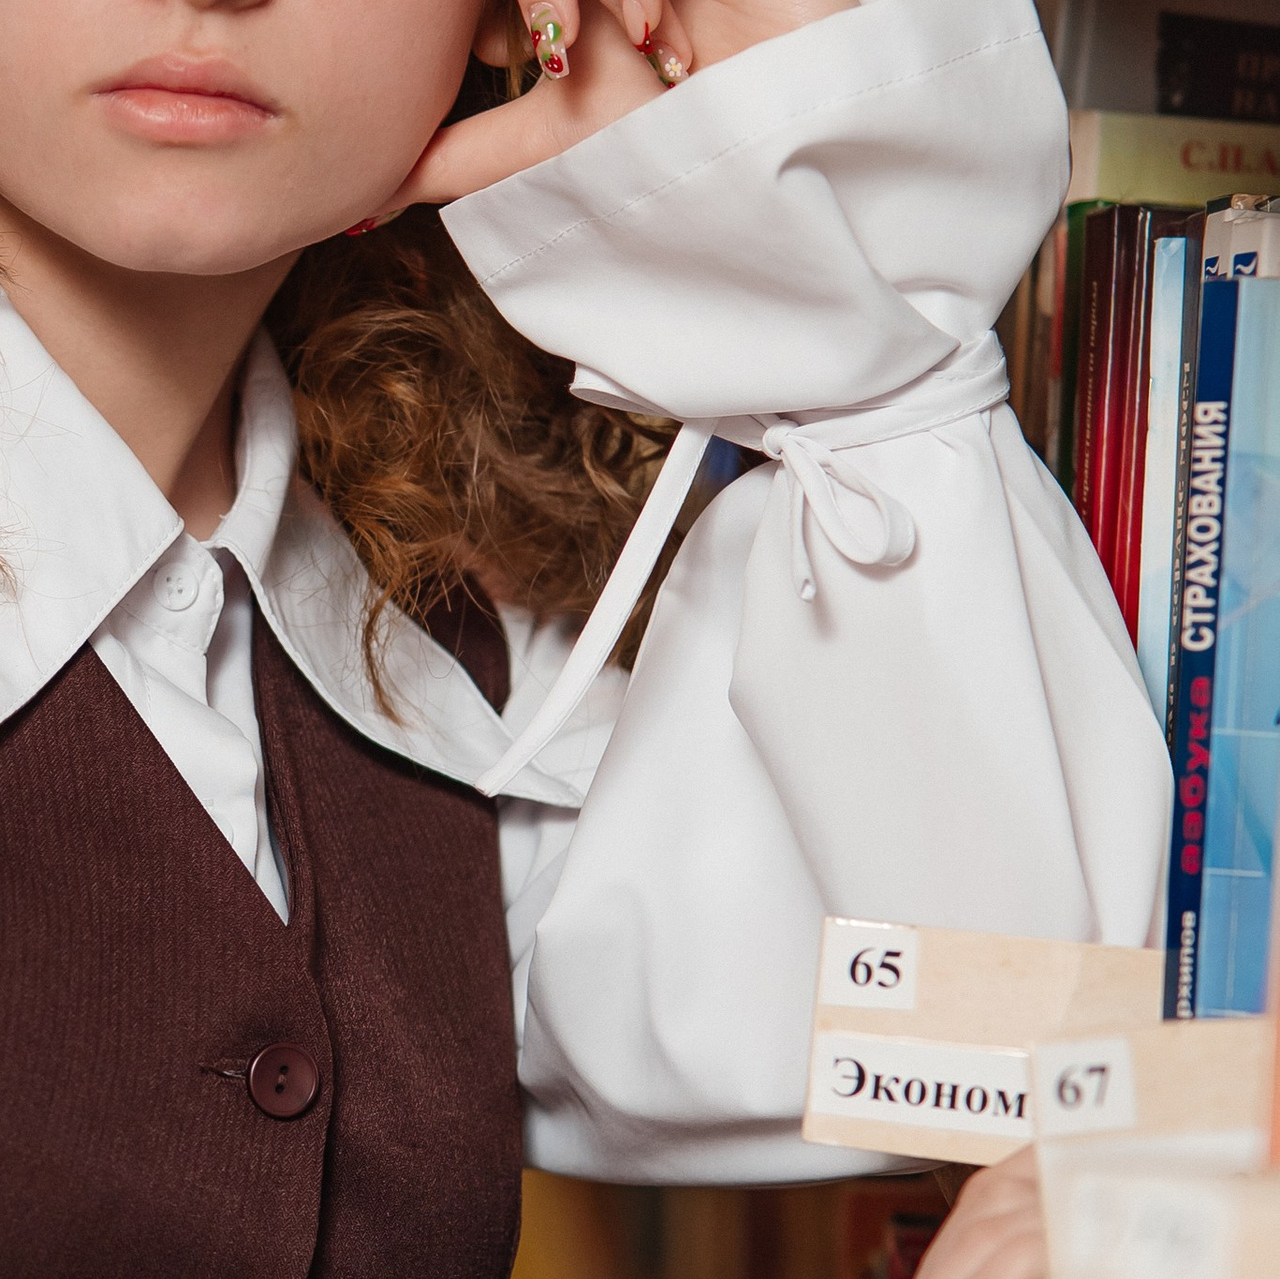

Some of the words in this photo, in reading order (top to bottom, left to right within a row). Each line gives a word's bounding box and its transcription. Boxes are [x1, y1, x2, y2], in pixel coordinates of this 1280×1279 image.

[1180, 400, 1229, 652] СТРАХОВАНИЯ
[1178, 675, 1212, 876] азбука
[848, 947, 905, 990] 65
[830, 1057, 1029, 1120] Эконом
[1055, 1064, 1111, 1108] 67
